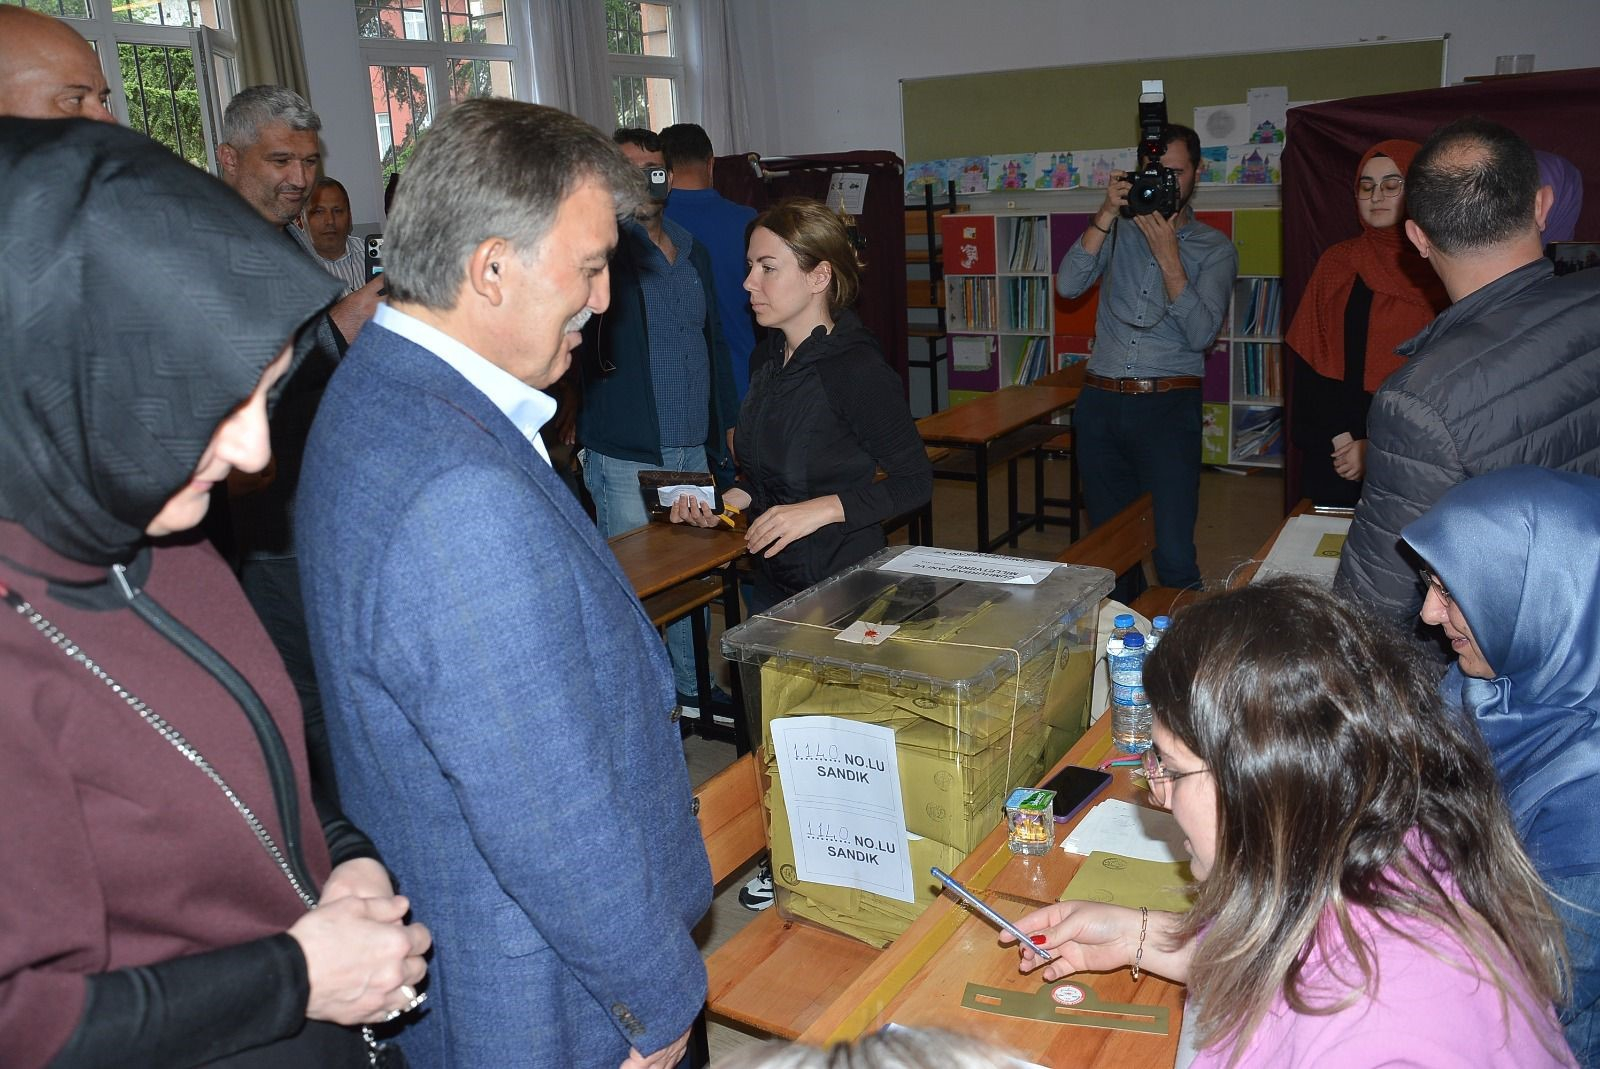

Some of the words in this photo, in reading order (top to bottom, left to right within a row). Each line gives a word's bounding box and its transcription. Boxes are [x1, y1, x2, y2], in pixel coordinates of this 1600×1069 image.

[844, 753, 885, 772] NO.LU
[817, 766, 870, 784] SANDIK
[854, 835, 896, 854] NO.LU
[827, 846, 879, 865] SANDIK
